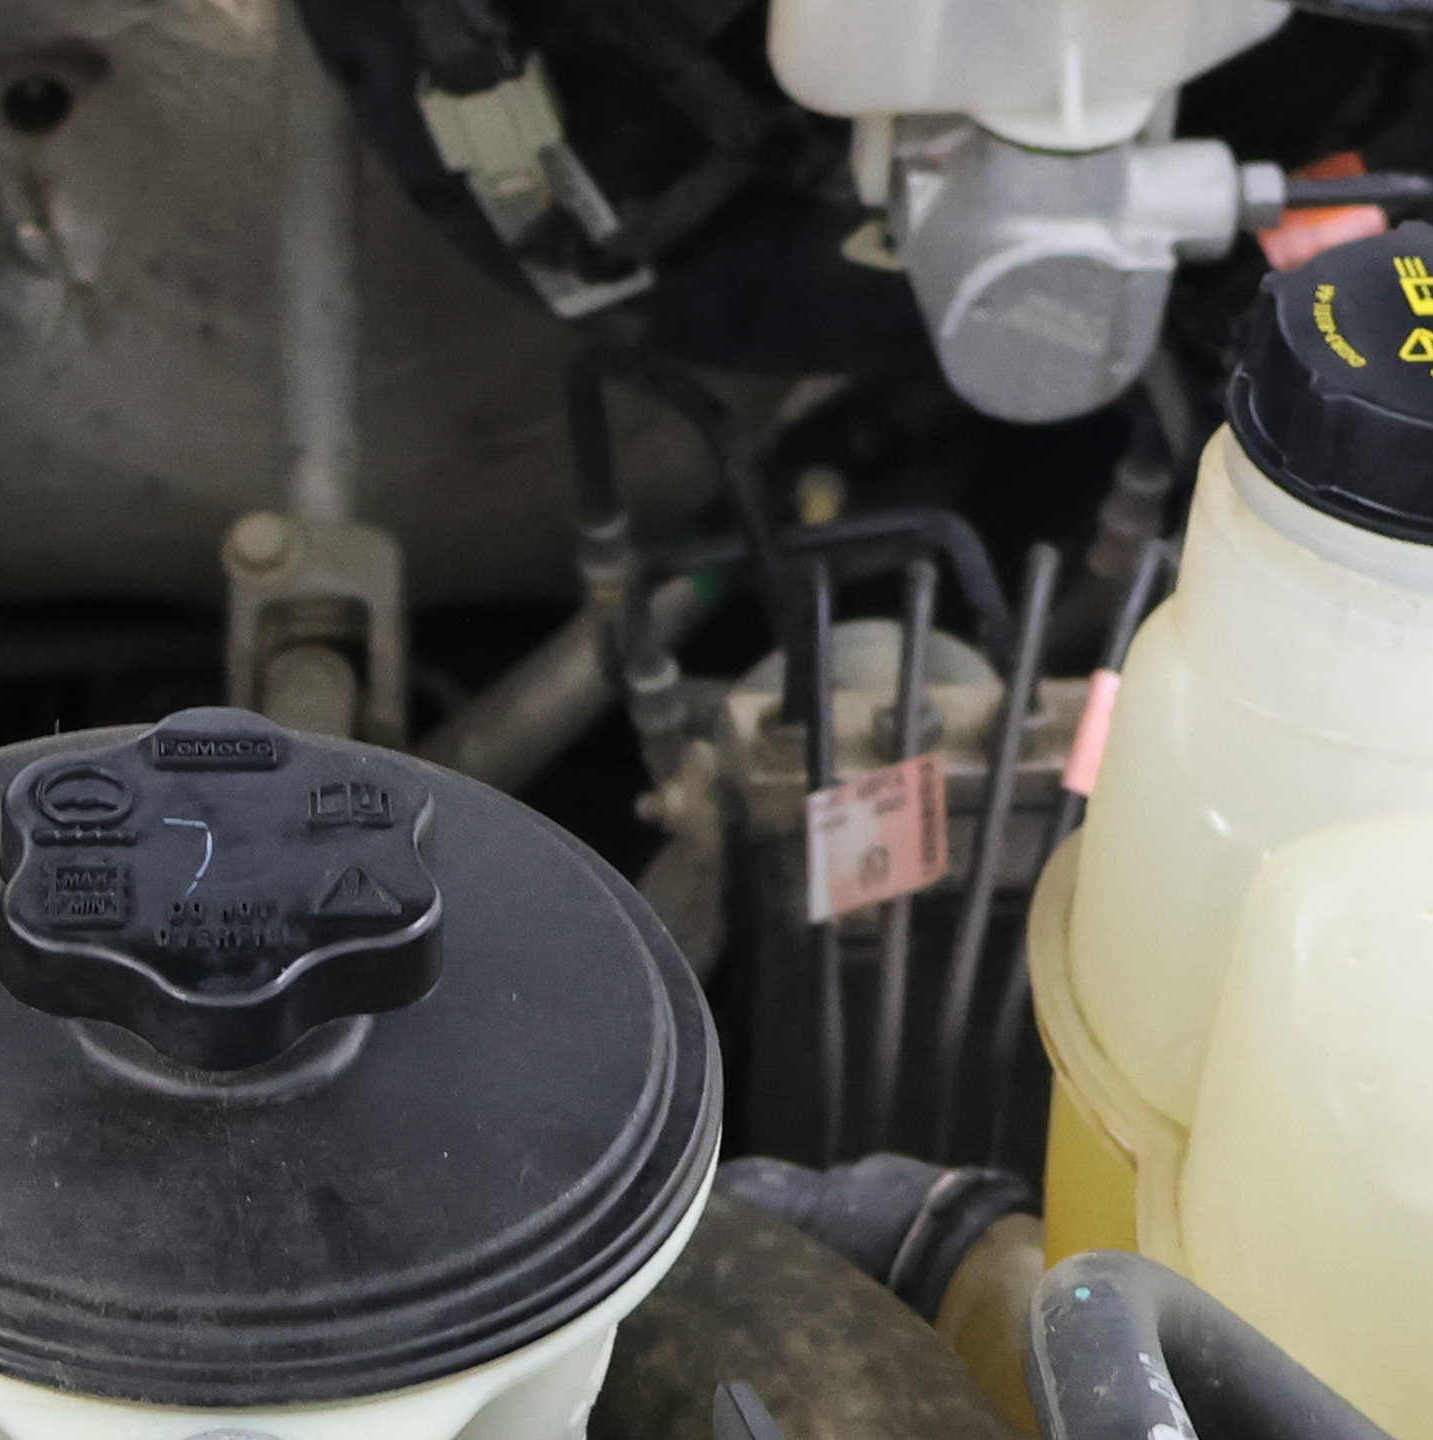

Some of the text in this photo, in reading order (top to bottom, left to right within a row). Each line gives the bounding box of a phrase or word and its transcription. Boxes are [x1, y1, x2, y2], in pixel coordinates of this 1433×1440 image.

[157, 739, 273, 758] FoMoCo
[62, 870, 110, 888] MAX
[67, 898, 107, 914] MIN
